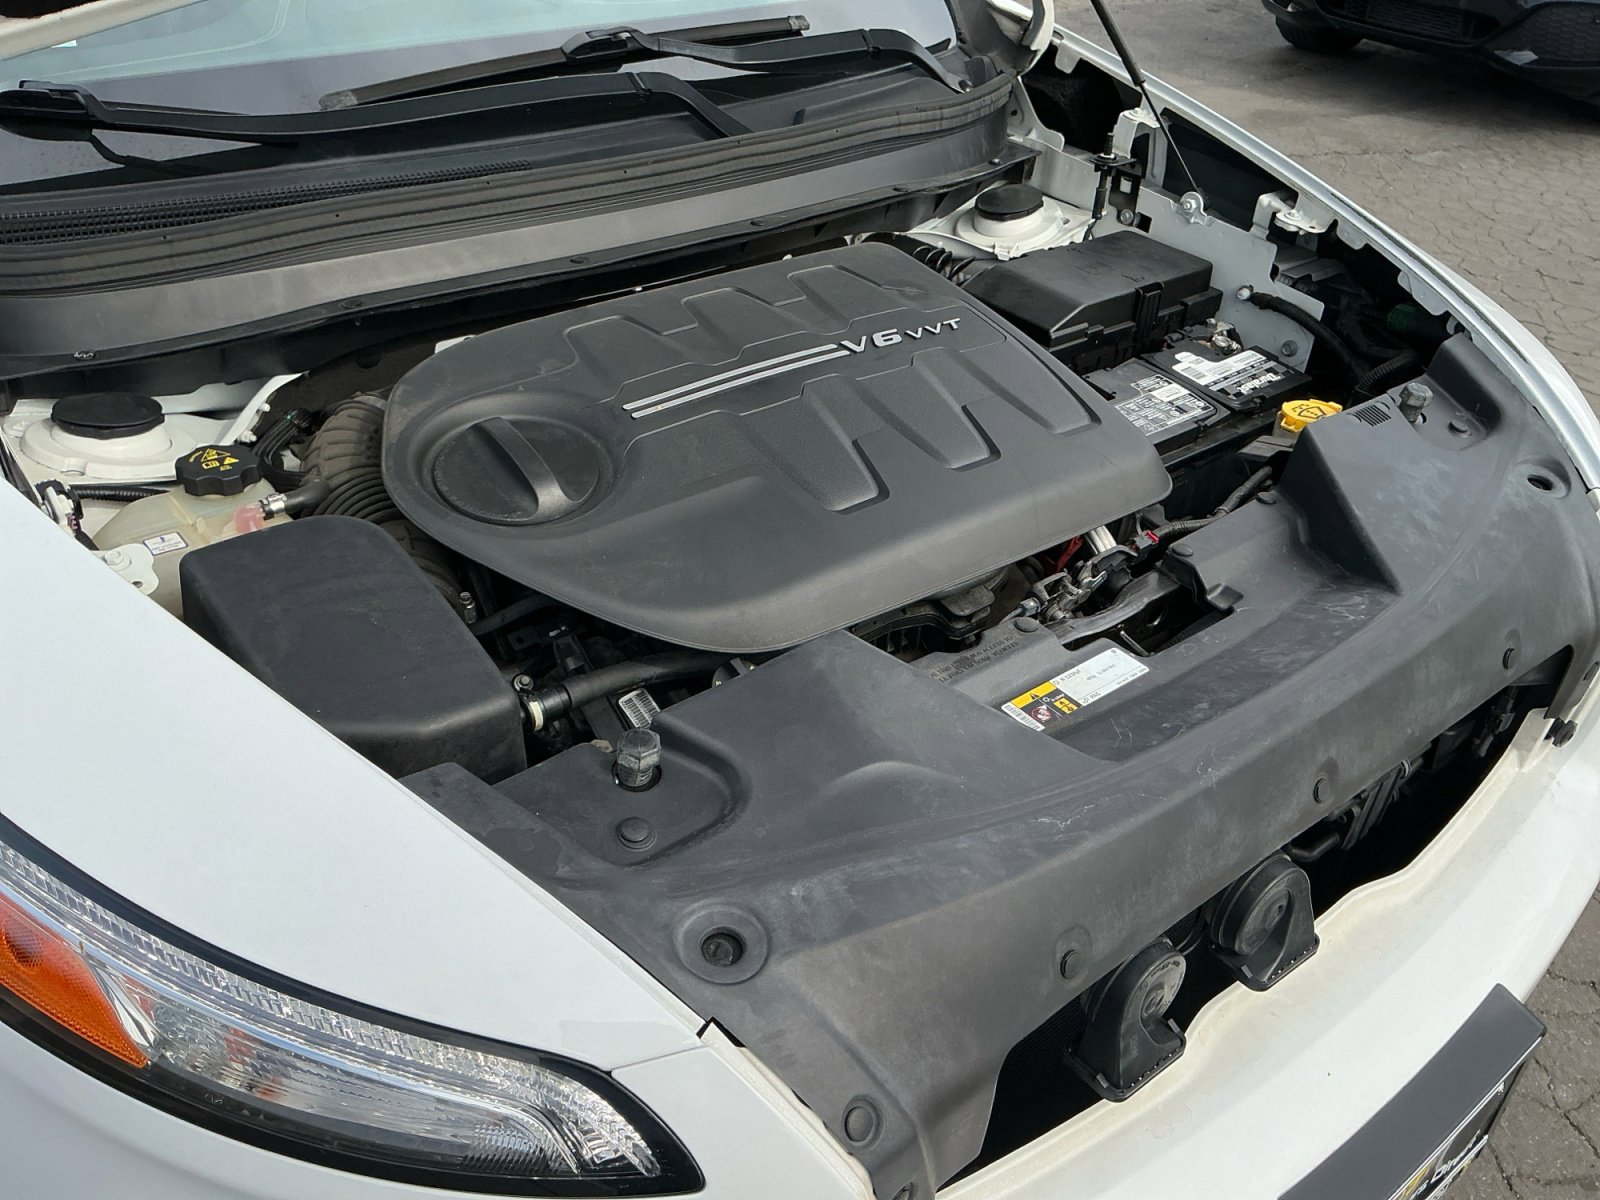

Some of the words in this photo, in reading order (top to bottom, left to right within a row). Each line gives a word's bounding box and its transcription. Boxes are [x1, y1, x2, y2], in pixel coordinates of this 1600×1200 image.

[840, 328, 903, 353] V6
[904, 317, 960, 339] VVT
[1236, 372, 1281, 396] Duralast
